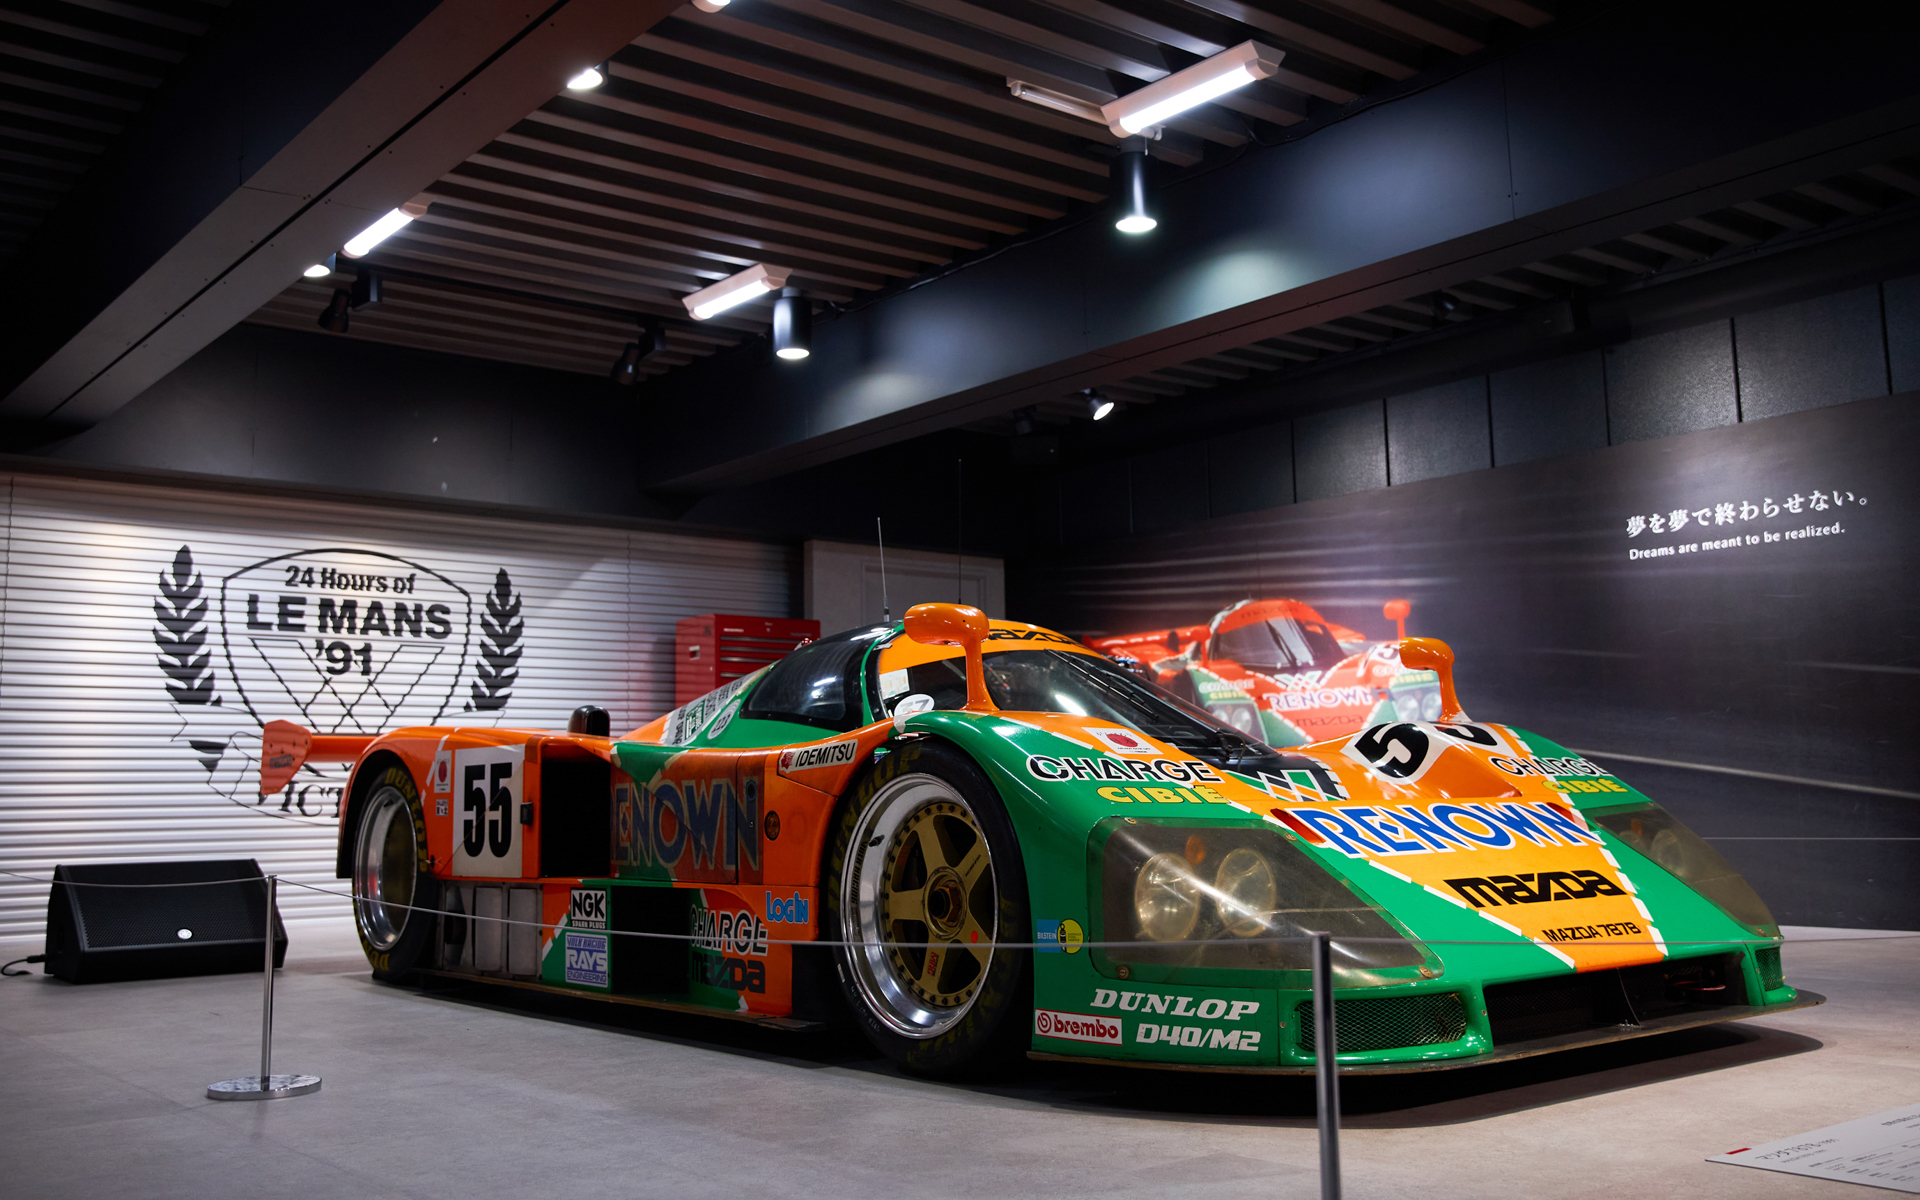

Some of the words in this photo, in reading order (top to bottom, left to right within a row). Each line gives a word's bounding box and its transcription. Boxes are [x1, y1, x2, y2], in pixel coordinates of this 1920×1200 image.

[1626, 489, 1867, 538] 夢を夢で終わらせない。
[1629, 545, 1675, 560] Dreams
[1678, 542, 1698, 554] are
[1702, 535, 1742, 551] meant
[1745, 531, 1760, 546] to
[1764, 528, 1780, 543] be
[1785, 521, 1846, 540] realized.
[284, 565, 315, 588] 24
[319, 567, 388, 593] Hours
[392, 573, 417, 595] of
[247, 594, 307, 632] LE
[317, 598, 453, 640] MANS
[314, 640, 373, 677] '91
[1263, 684, 1373, 712] RENOWN
[795, 742, 856, 768] IDEMITSU
[1026, 755, 1226, 784] CHARGE
[463, 762, 513, 858] 55
[611, 776, 760, 872] ENOWN
[1284, 801, 1608, 860] RENOWN
[572, 892, 605, 919] NGK
[572, 920, 588, 928] SPARK
[589, 921, 606, 929] PLUGS
[691, 904, 769, 956] CHARGE
[1037, 931, 1057, 940] BILSTEIN
[1542, 925, 1600, 943] MAZDA
[1598, 922, 1643, 938] 787B
[566, 949, 607, 972] RAYS
[566, 970, 607, 983] ENGINEERING
[1090, 988, 1260, 1021] DUNLOP
[1053, 1015, 1119, 1039] brembo
[1135, 1023, 1262, 1052] D40/M2
